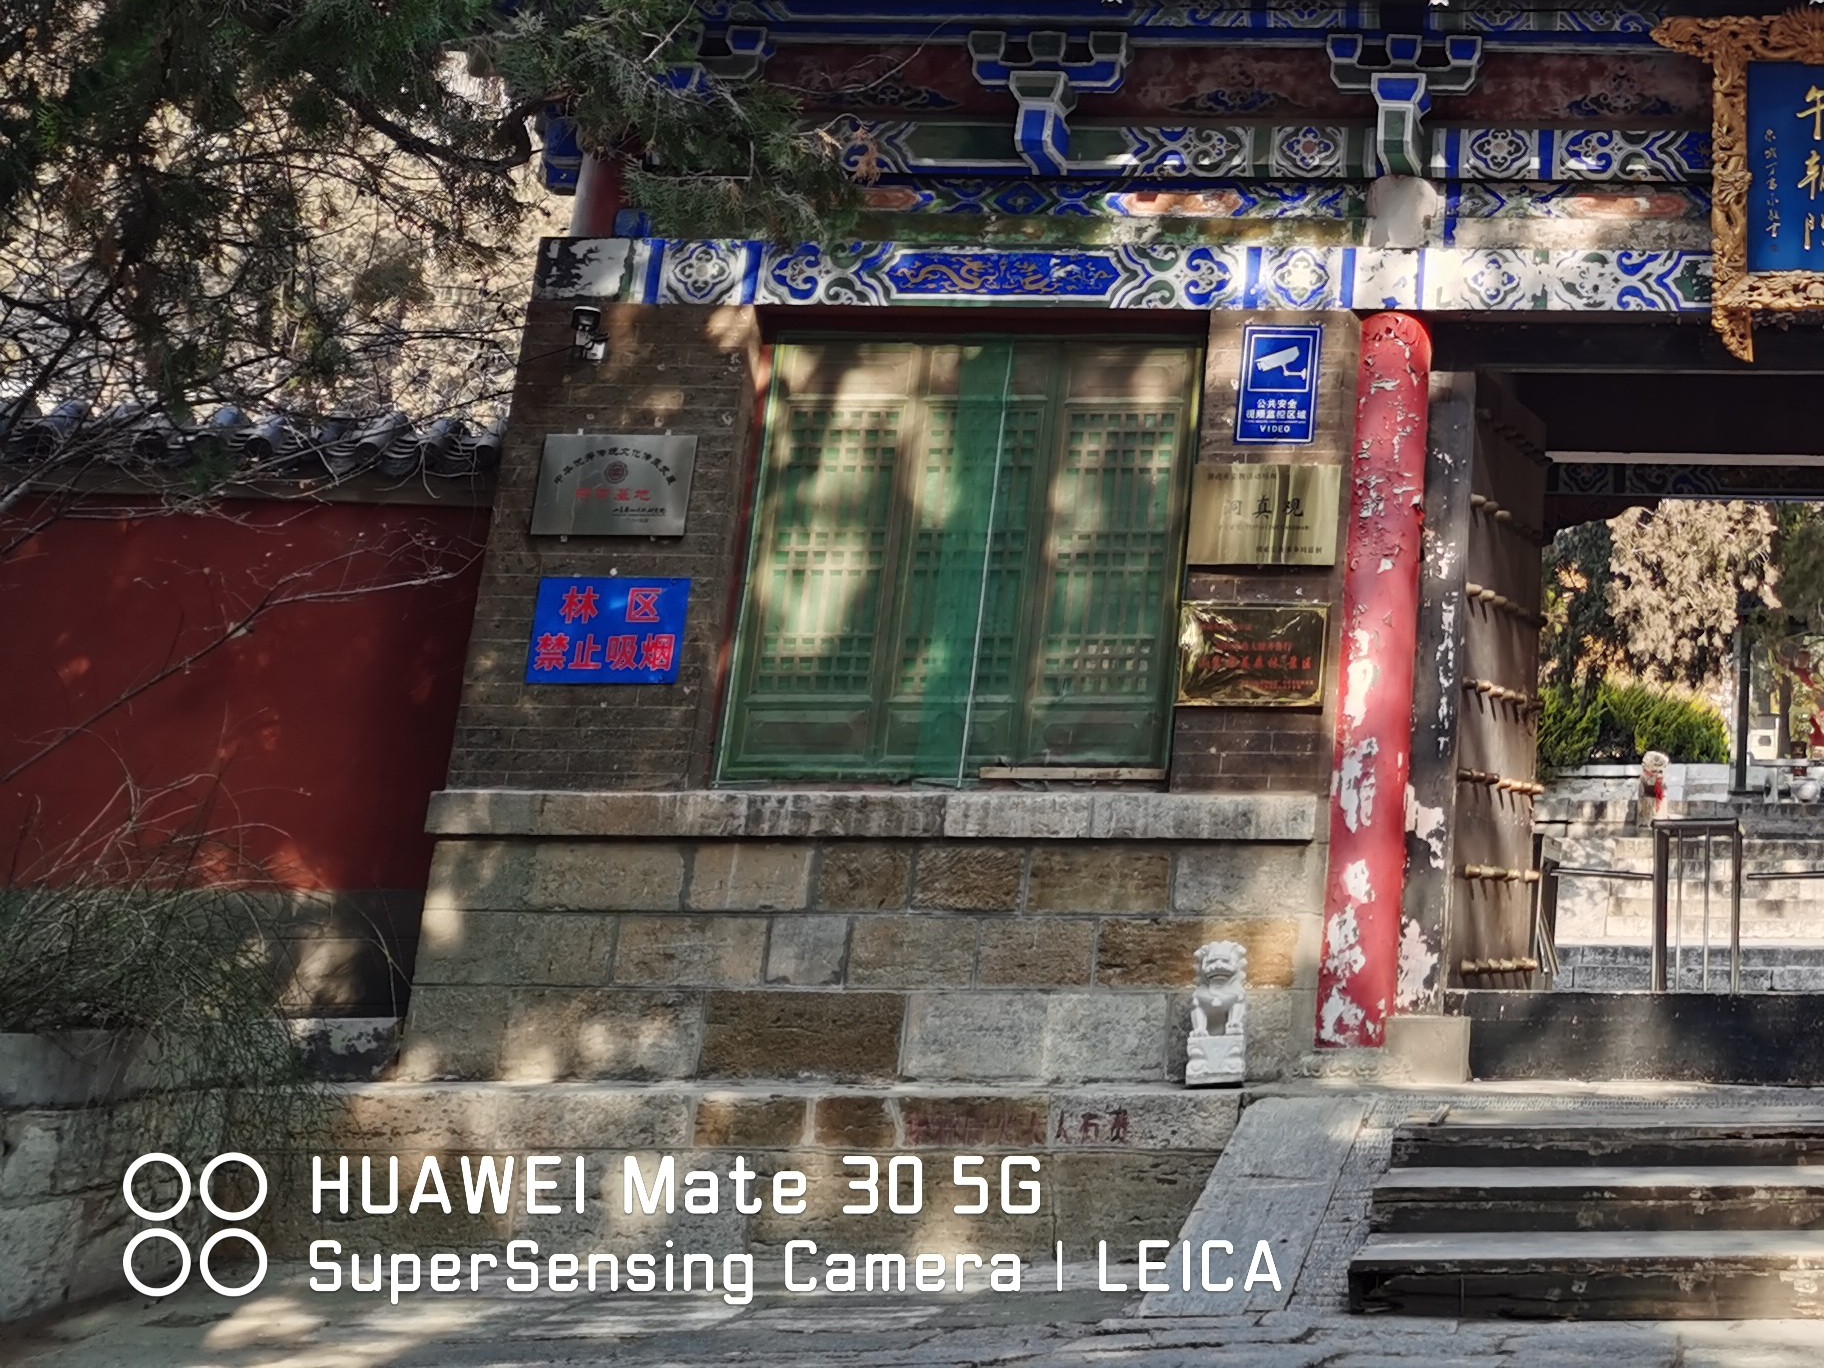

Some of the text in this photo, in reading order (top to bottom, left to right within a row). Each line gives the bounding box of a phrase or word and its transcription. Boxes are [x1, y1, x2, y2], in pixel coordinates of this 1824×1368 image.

[1256, 398, 1297, 409] 公共安全
[1259, 425, 1290, 433] VIDEO
[560, 586, 663, 624] 林区
[533, 632, 675, 671] 禁止吸烟
